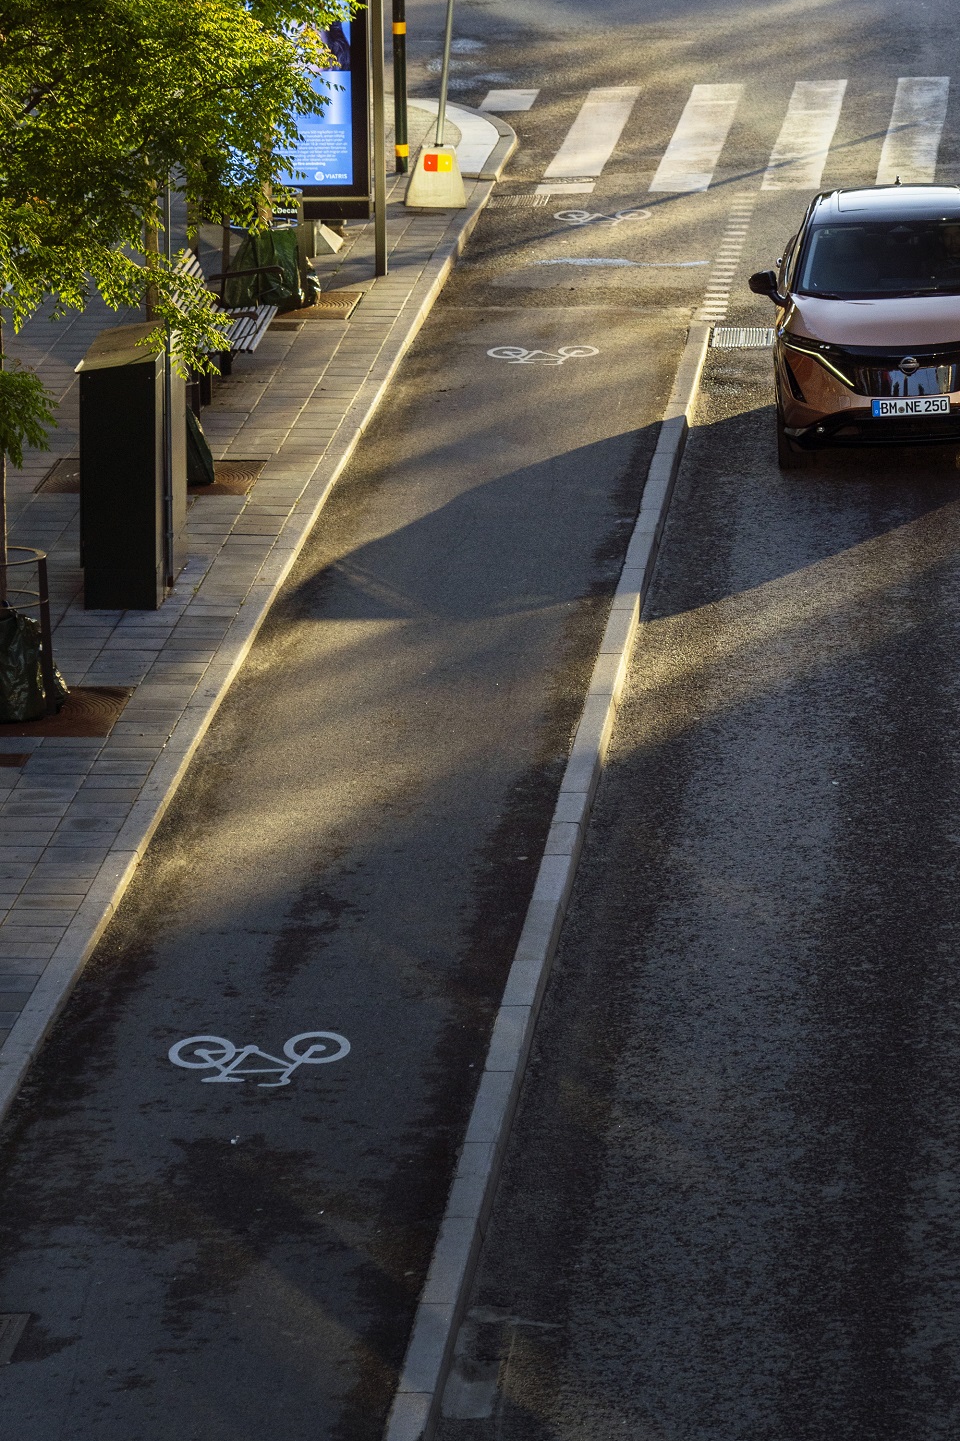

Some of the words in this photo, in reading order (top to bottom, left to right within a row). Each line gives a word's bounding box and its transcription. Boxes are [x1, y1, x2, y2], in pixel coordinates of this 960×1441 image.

[880, 402, 897, 414] BM
[906, 401, 922, 413] NE
[924, 399, 948, 412] 250
